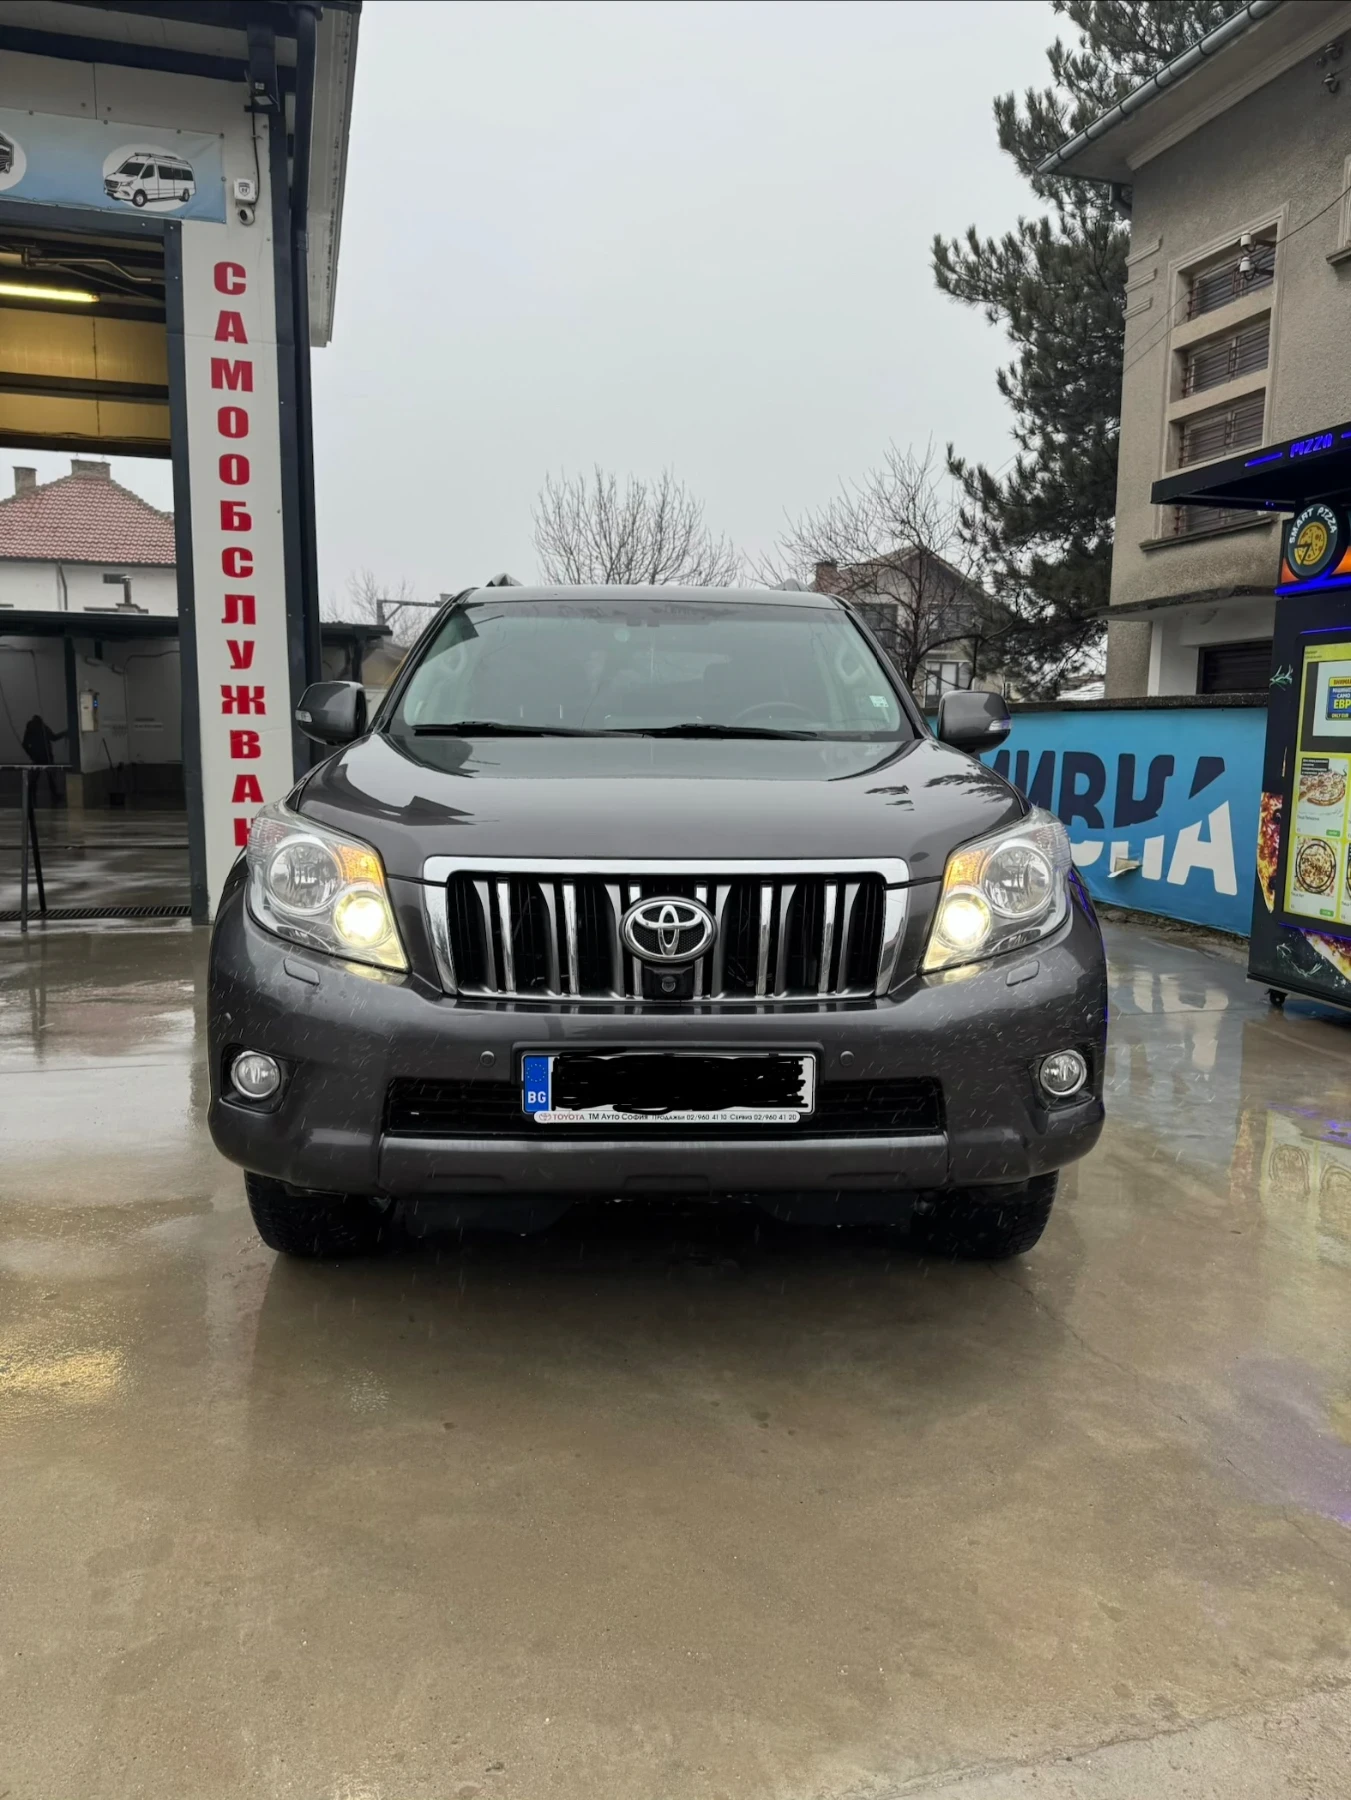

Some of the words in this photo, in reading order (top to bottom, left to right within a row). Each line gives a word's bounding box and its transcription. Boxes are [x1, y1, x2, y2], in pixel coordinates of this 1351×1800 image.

[1289, 507, 1315, 544] SMART
[1316, 506, 1339, 534] PIZZA
[527, 1091, 547, 1104] BG
[553, 1113, 585, 1121] TOYOTA
[754, 1113, 777, 1121] 02/960
[788, 1113, 797, 1121] 20
